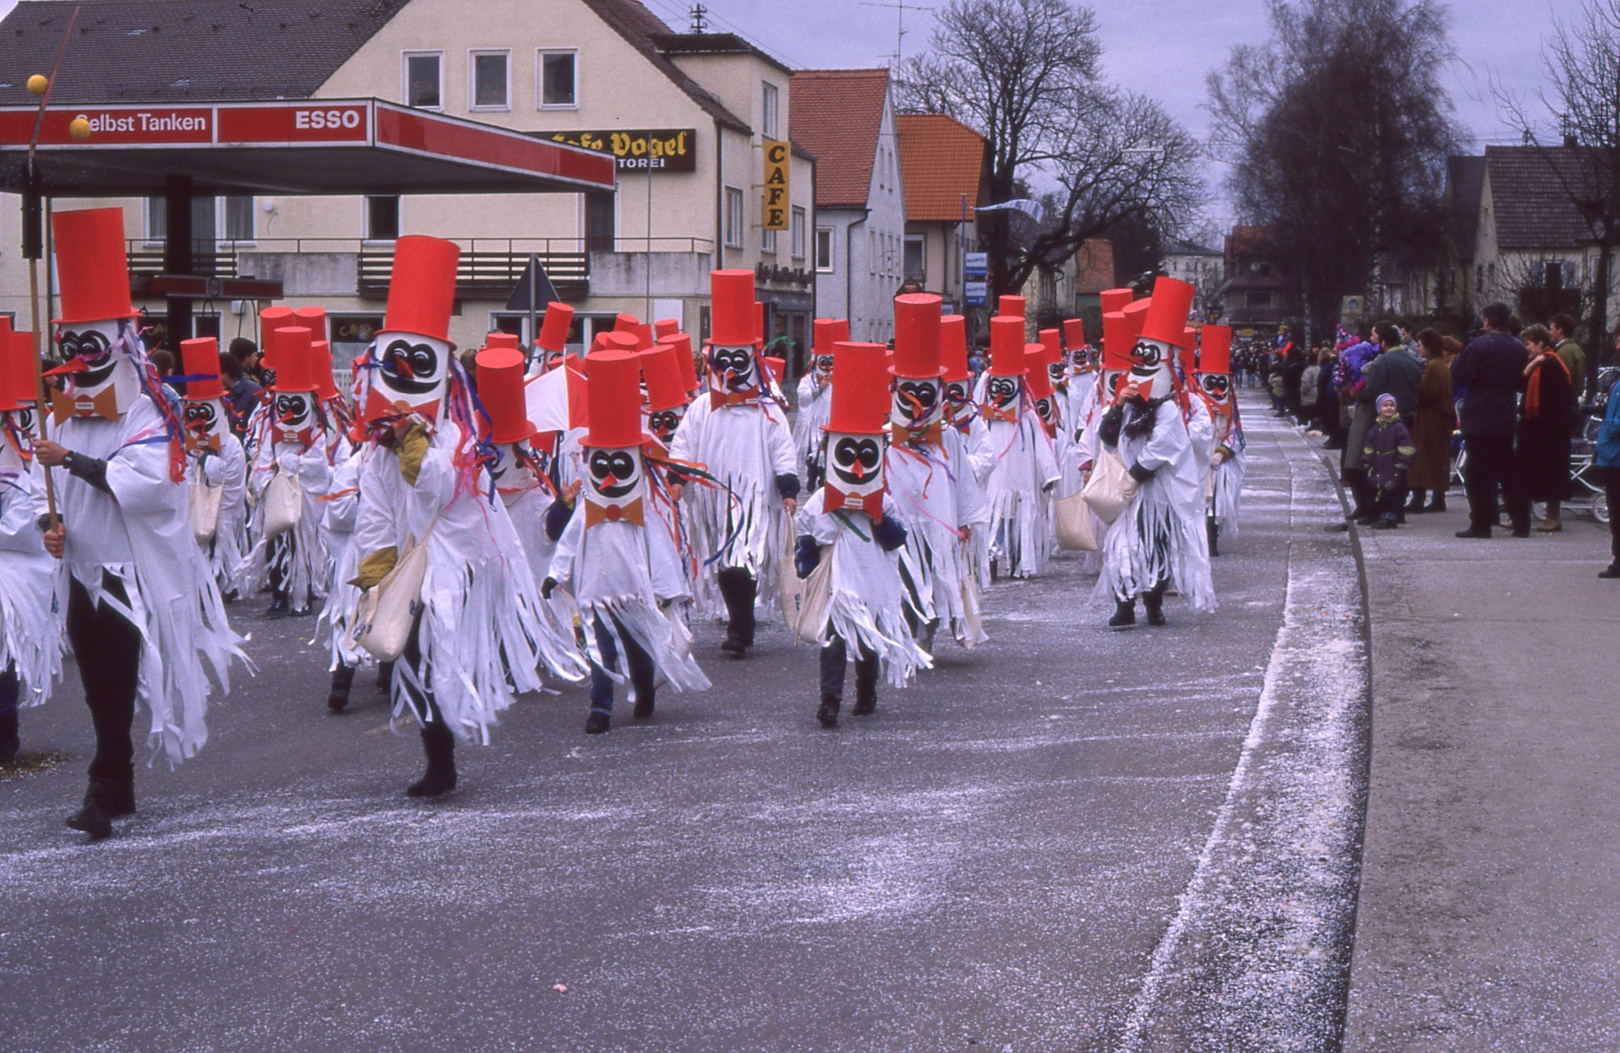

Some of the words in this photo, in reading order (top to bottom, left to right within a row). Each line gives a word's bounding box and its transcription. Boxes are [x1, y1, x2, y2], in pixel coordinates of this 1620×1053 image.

[76, 114, 135, 132] elbst
[137, 113, 206, 131] Tanken
[295, 109, 360, 129] ESSO
[610, 130, 687, 158] Vogel
[767, 145, 786, 226] CAFE
